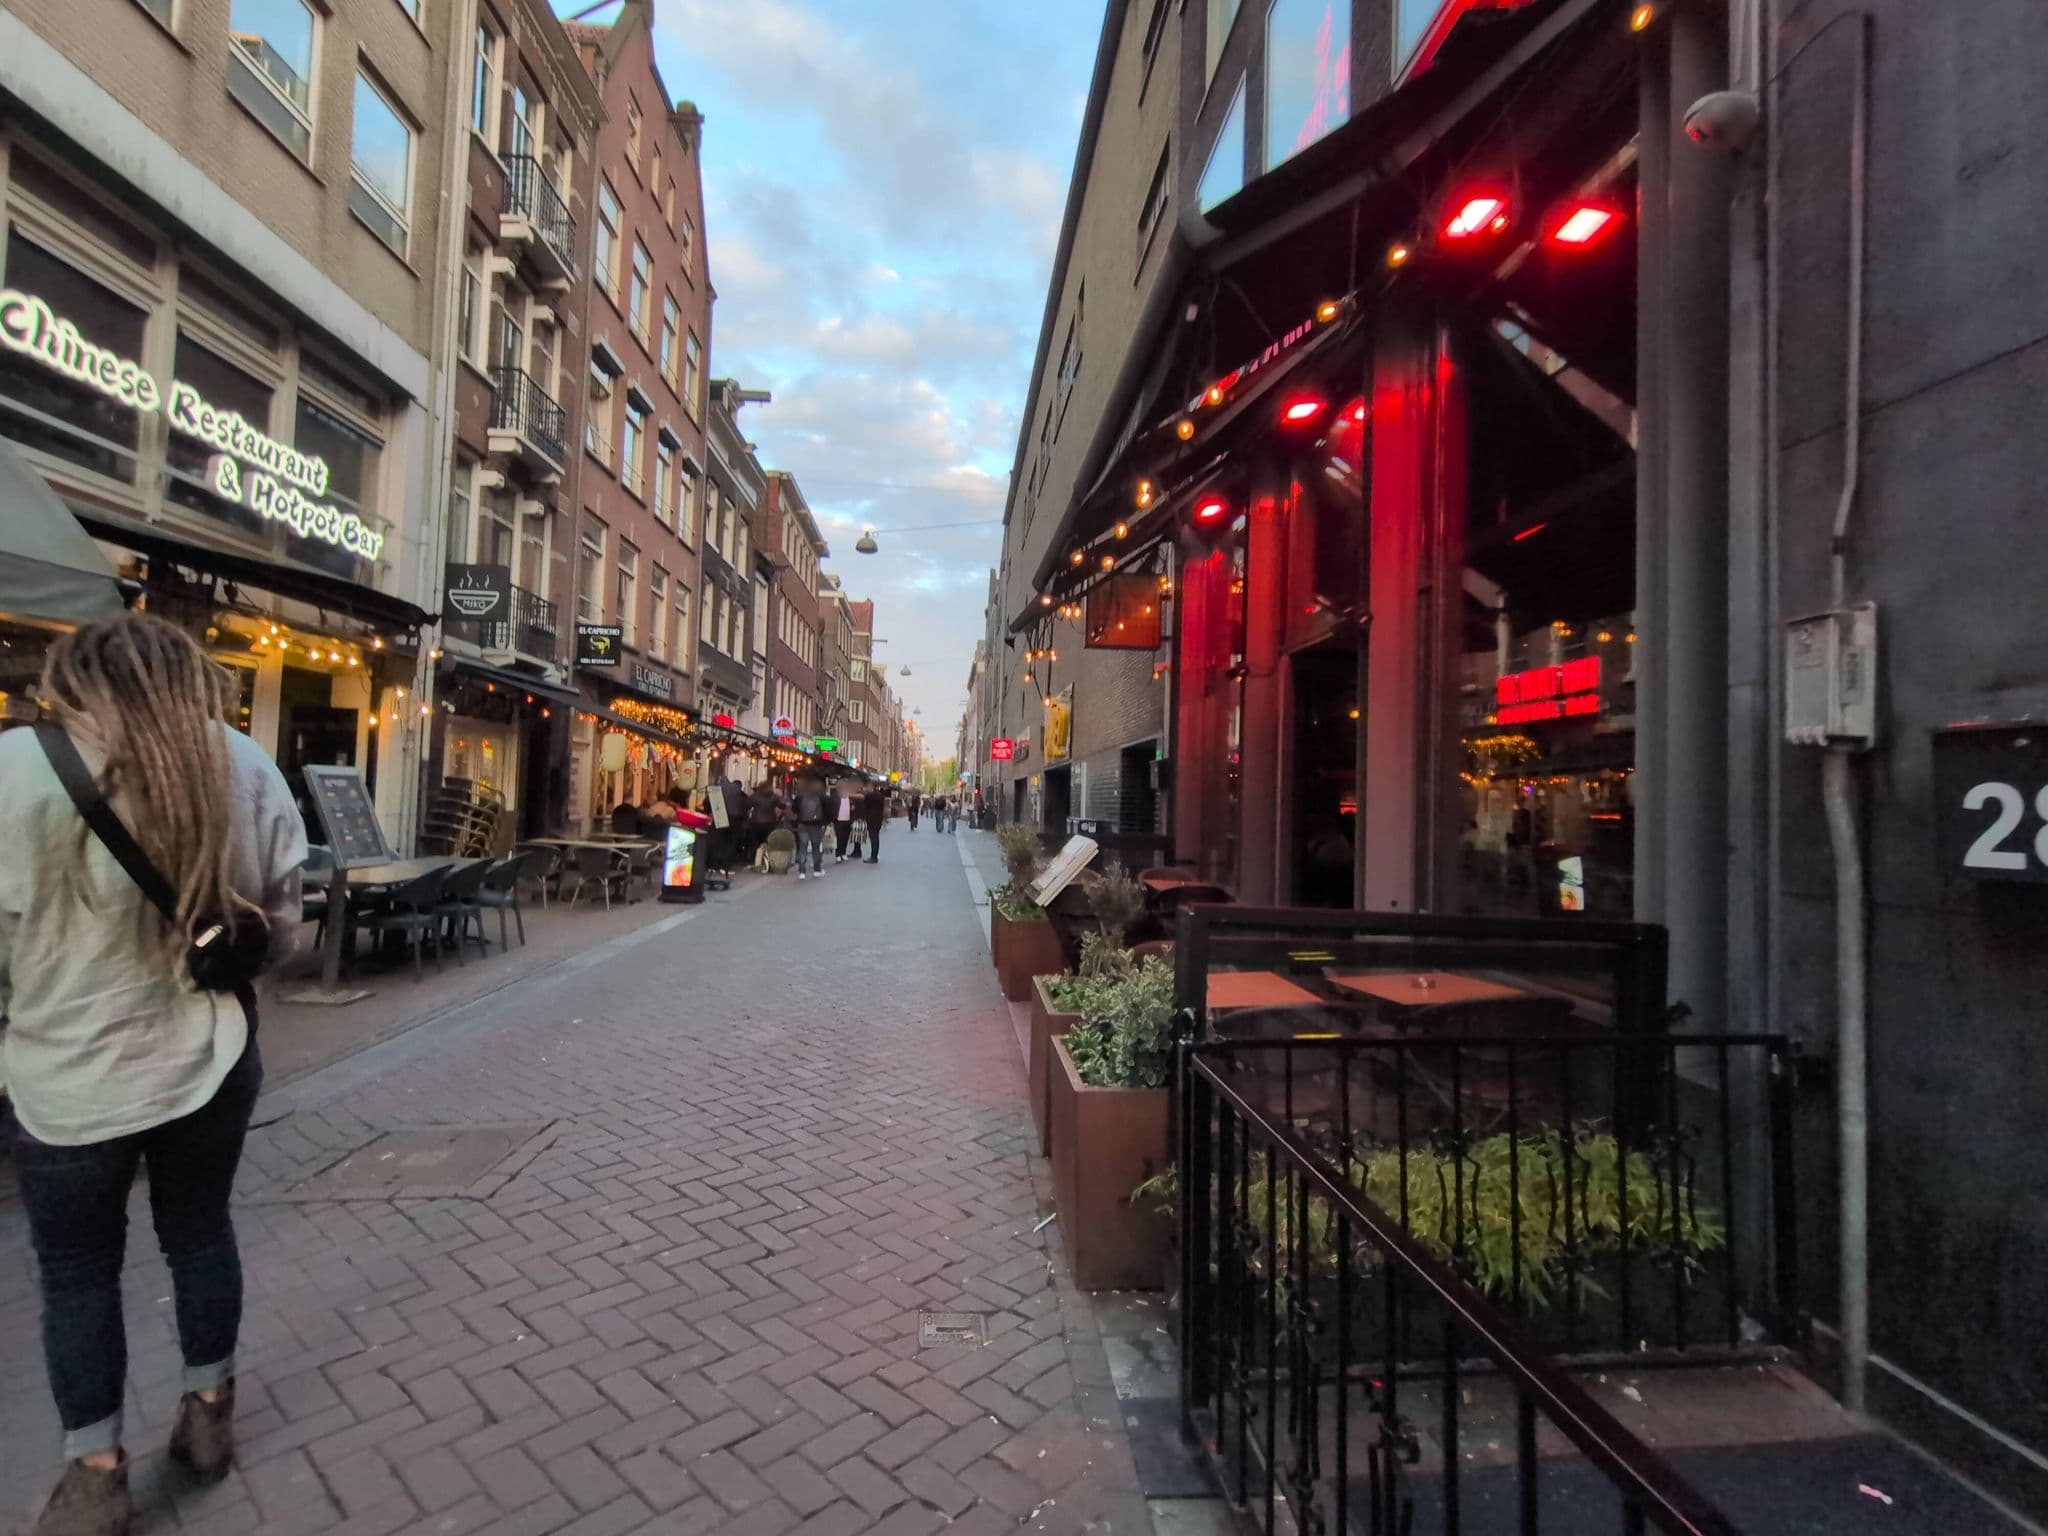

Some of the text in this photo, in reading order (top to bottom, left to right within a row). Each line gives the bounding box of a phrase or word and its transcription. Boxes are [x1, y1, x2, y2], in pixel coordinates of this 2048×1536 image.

[0, 294, 328, 494] Chinese Restaurant
[217, 457, 383, 559] & Hotpot Bar
[1962, 781, 2048, 870] 2
